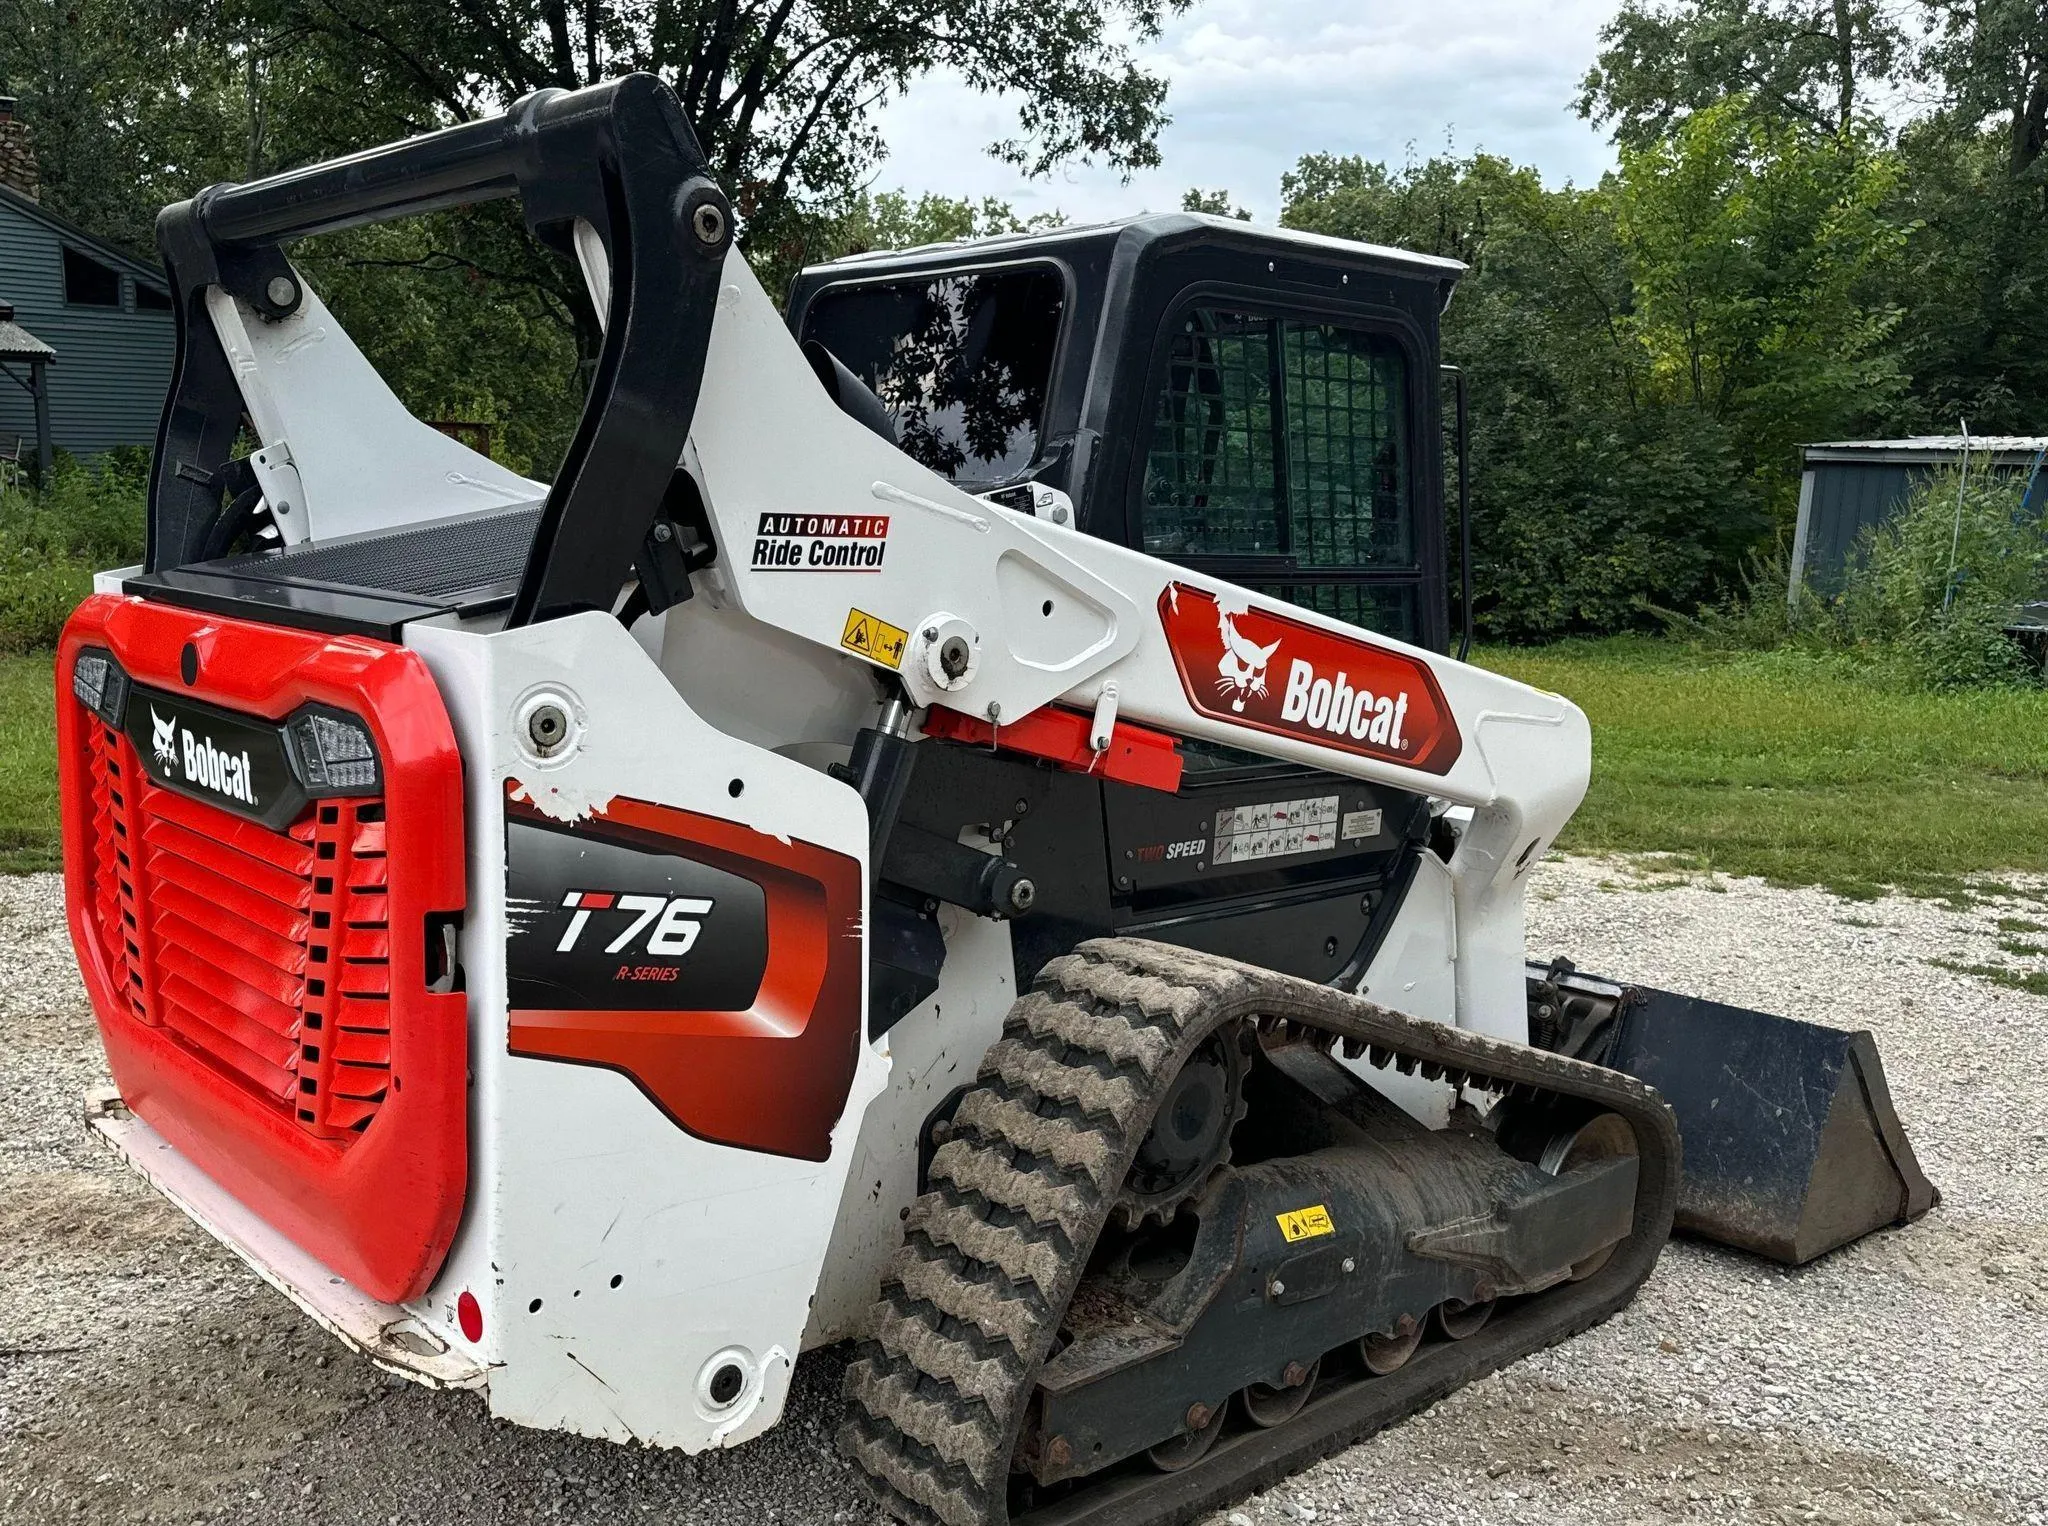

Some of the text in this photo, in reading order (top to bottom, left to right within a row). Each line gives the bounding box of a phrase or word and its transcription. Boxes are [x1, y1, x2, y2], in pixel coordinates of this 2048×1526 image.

[762, 516, 885, 536] AUTOMATIC
[751, 538, 886, 567] Ride Control
[1281, 657, 1408, 750] Bobcat
[180, 727, 254, 805] Bobcat
[1136, 839, 1206, 861] TWO SPEED
[556, 891, 715, 957] T76
[614, 965, 681, 982] R-SERIES
